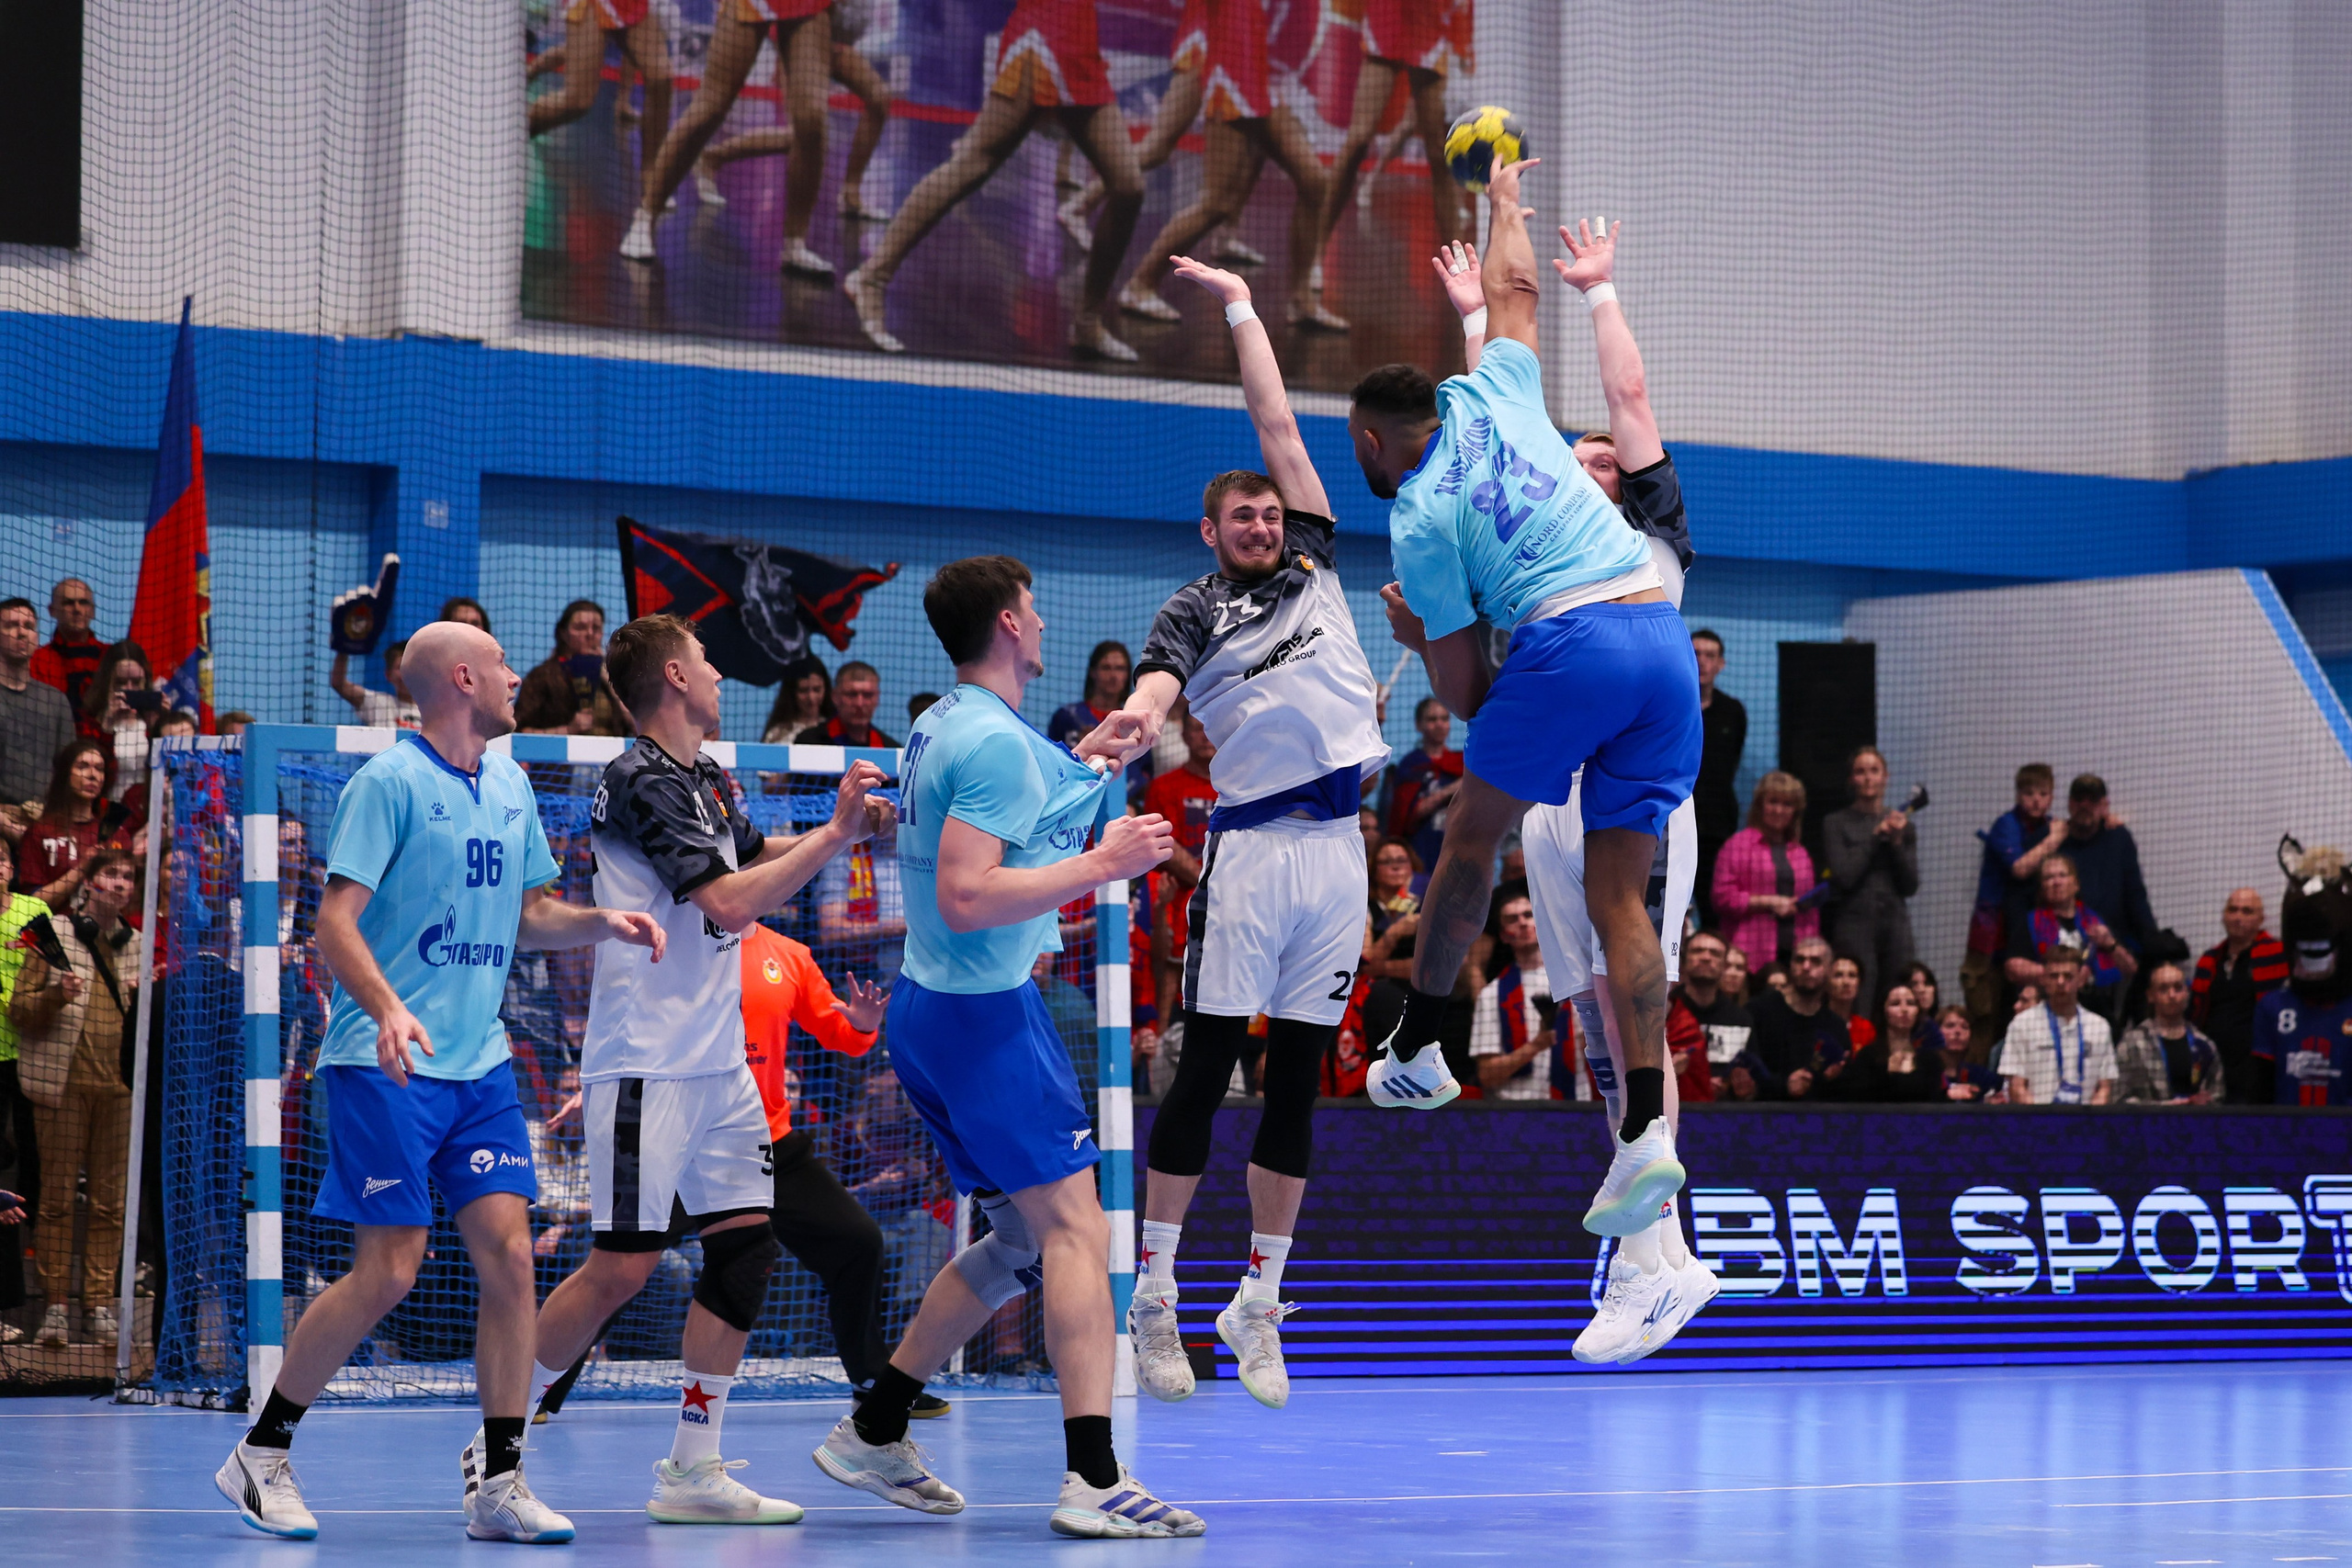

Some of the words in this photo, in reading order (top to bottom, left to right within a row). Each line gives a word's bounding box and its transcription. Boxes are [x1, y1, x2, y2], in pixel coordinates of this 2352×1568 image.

[1470, 440, 1558, 545] 23
[1531, 519, 1559, 550] NORD
[1213, 592, 1263, 636] 23
[1288, 649, 1317, 663] GROUP
[466, 838, 504, 888] 96
[1328, 970, 1356, 1001] 2
[2278, 1008, 2297, 1034] 8
[681, 1410, 709, 1425] ЦСКА
